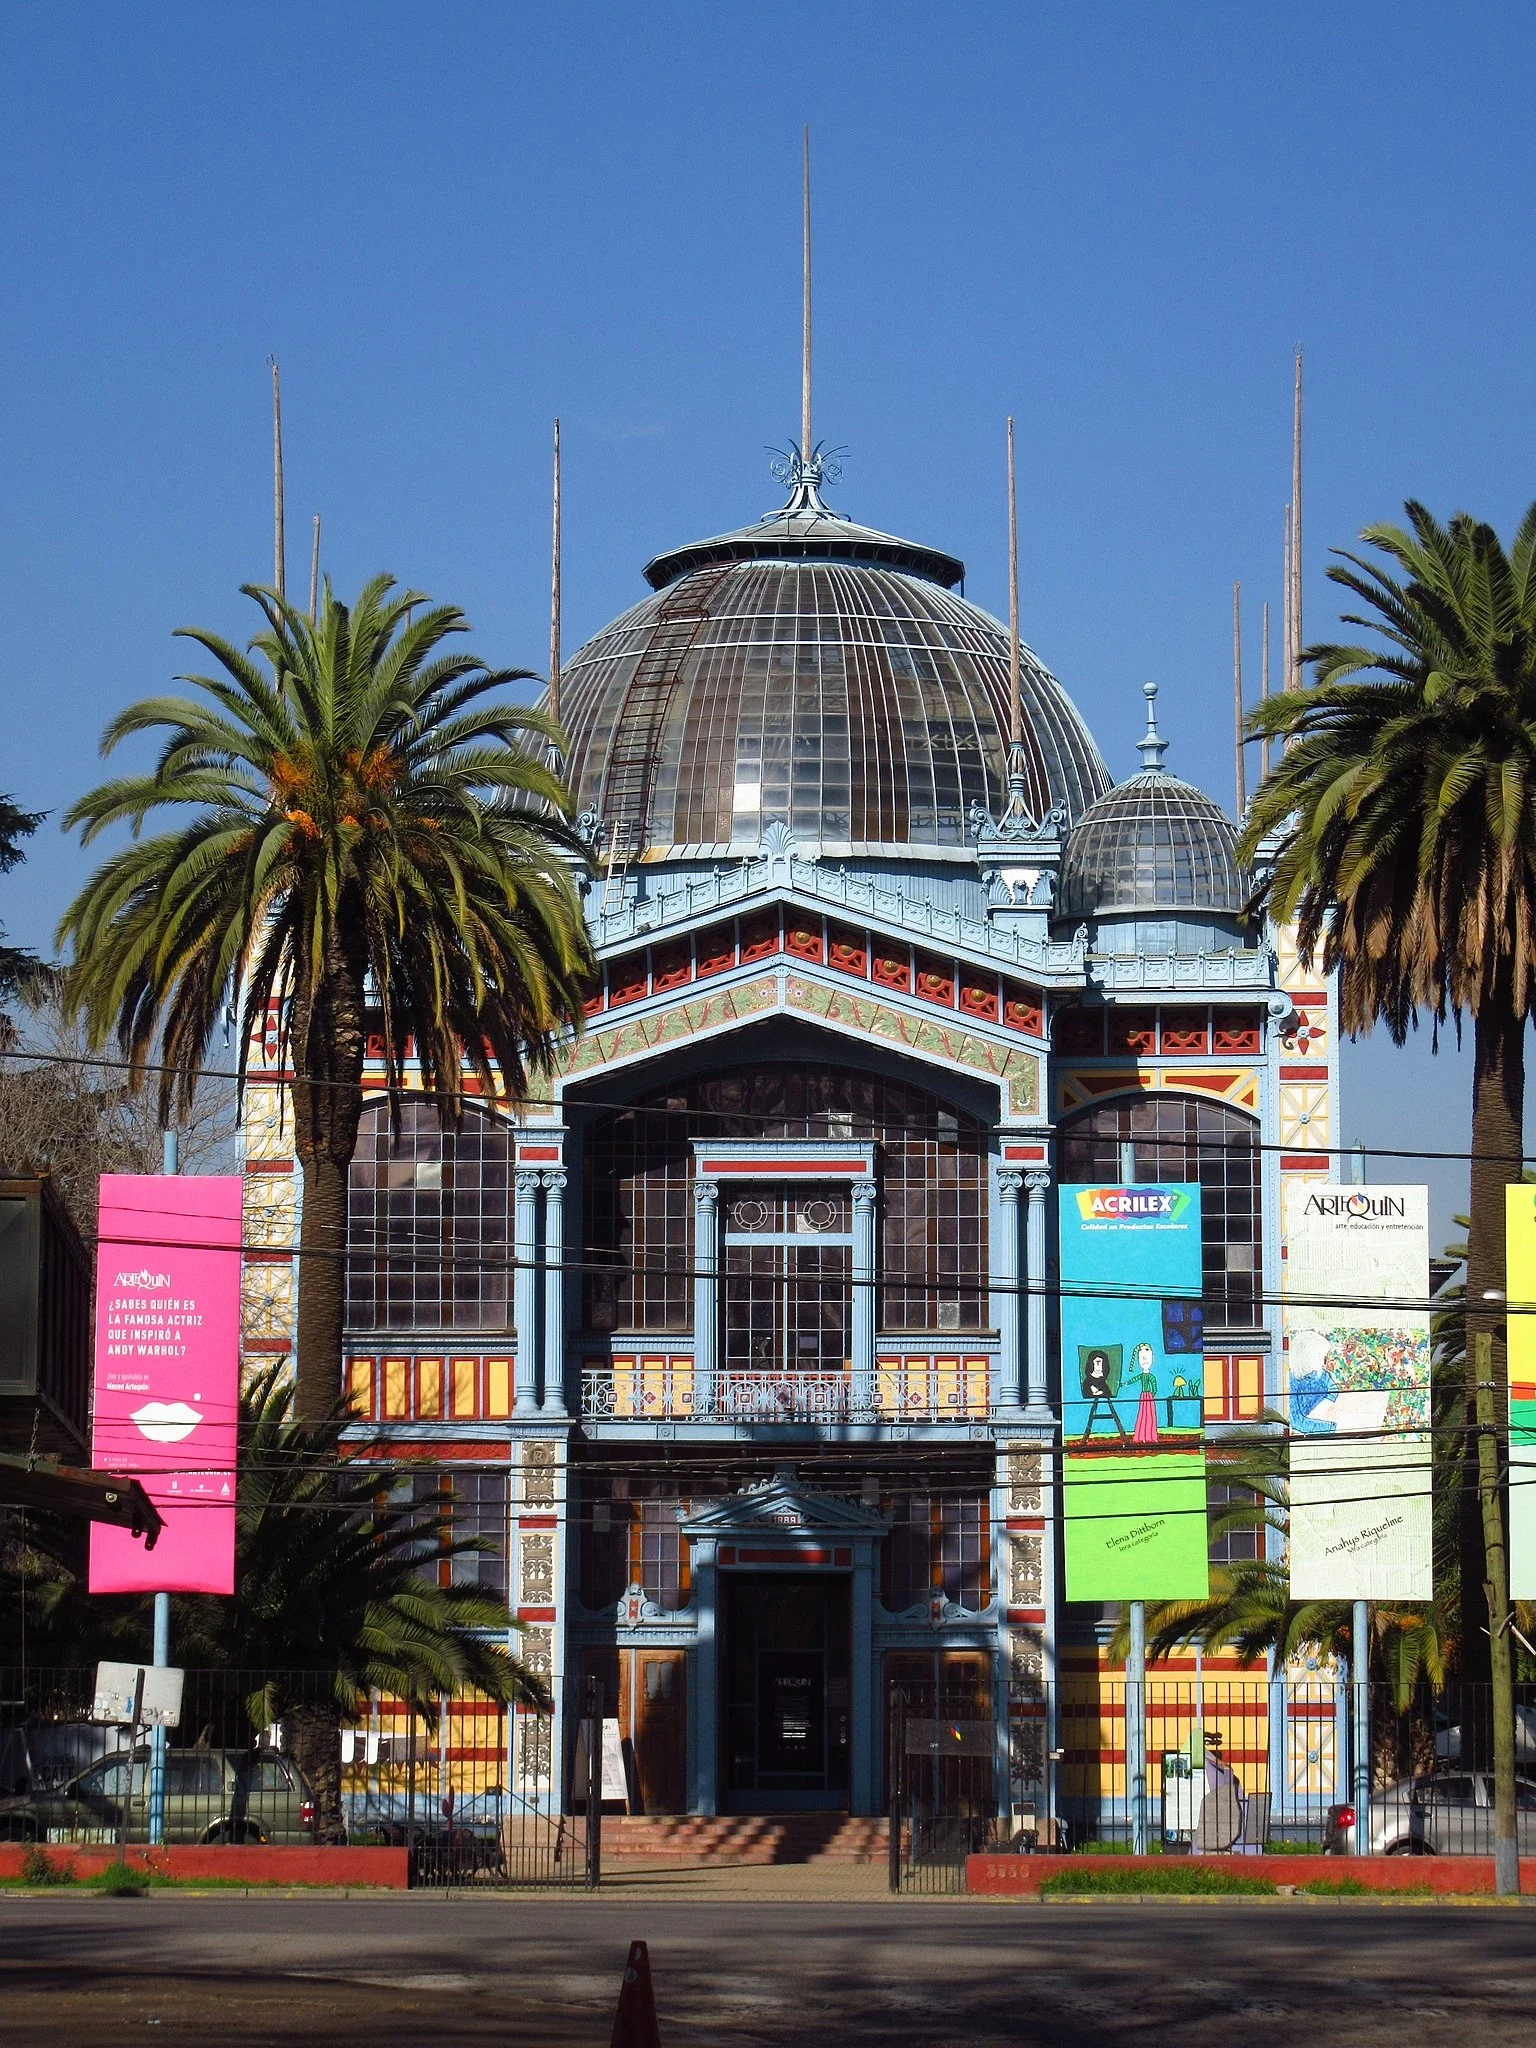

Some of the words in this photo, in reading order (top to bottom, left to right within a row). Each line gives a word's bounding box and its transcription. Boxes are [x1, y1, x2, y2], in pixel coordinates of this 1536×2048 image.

[1080, 1223, 1107, 1231] Calidad
[1118, 1223, 1154, 1231] Productos
[1155, 1222, 1188, 1230] Escolares
[1350, 1222, 1380, 1230] educación
[1385, 1222, 1424, 1231] entretención
[108, 1298, 147, 1312] ¿SABES
[149, 1297, 180, 1311] QUIÉN
[183, 1299, 196, 1311] ES
[108, 1314, 121, 1325] LA
[124, 1314, 164, 1326] FAMOSA
[167, 1315, 203, 1326] ACTRIZ
[107, 1329, 127, 1341] QUE
[130, 1328, 171, 1341] INSPIRÓ
[174, 1330, 181, 1341] A
[107, 1344, 134, 1356] ANDY
[137, 1345, 186, 1356] WARHOL?
[1105, 1535, 1130, 1549] Elena
[1129, 1519, 1166, 1539] Dittborn
[1325, 1536, 1360, 1556] Anahys
[1360, 1516, 1404, 1539] Riquelme
